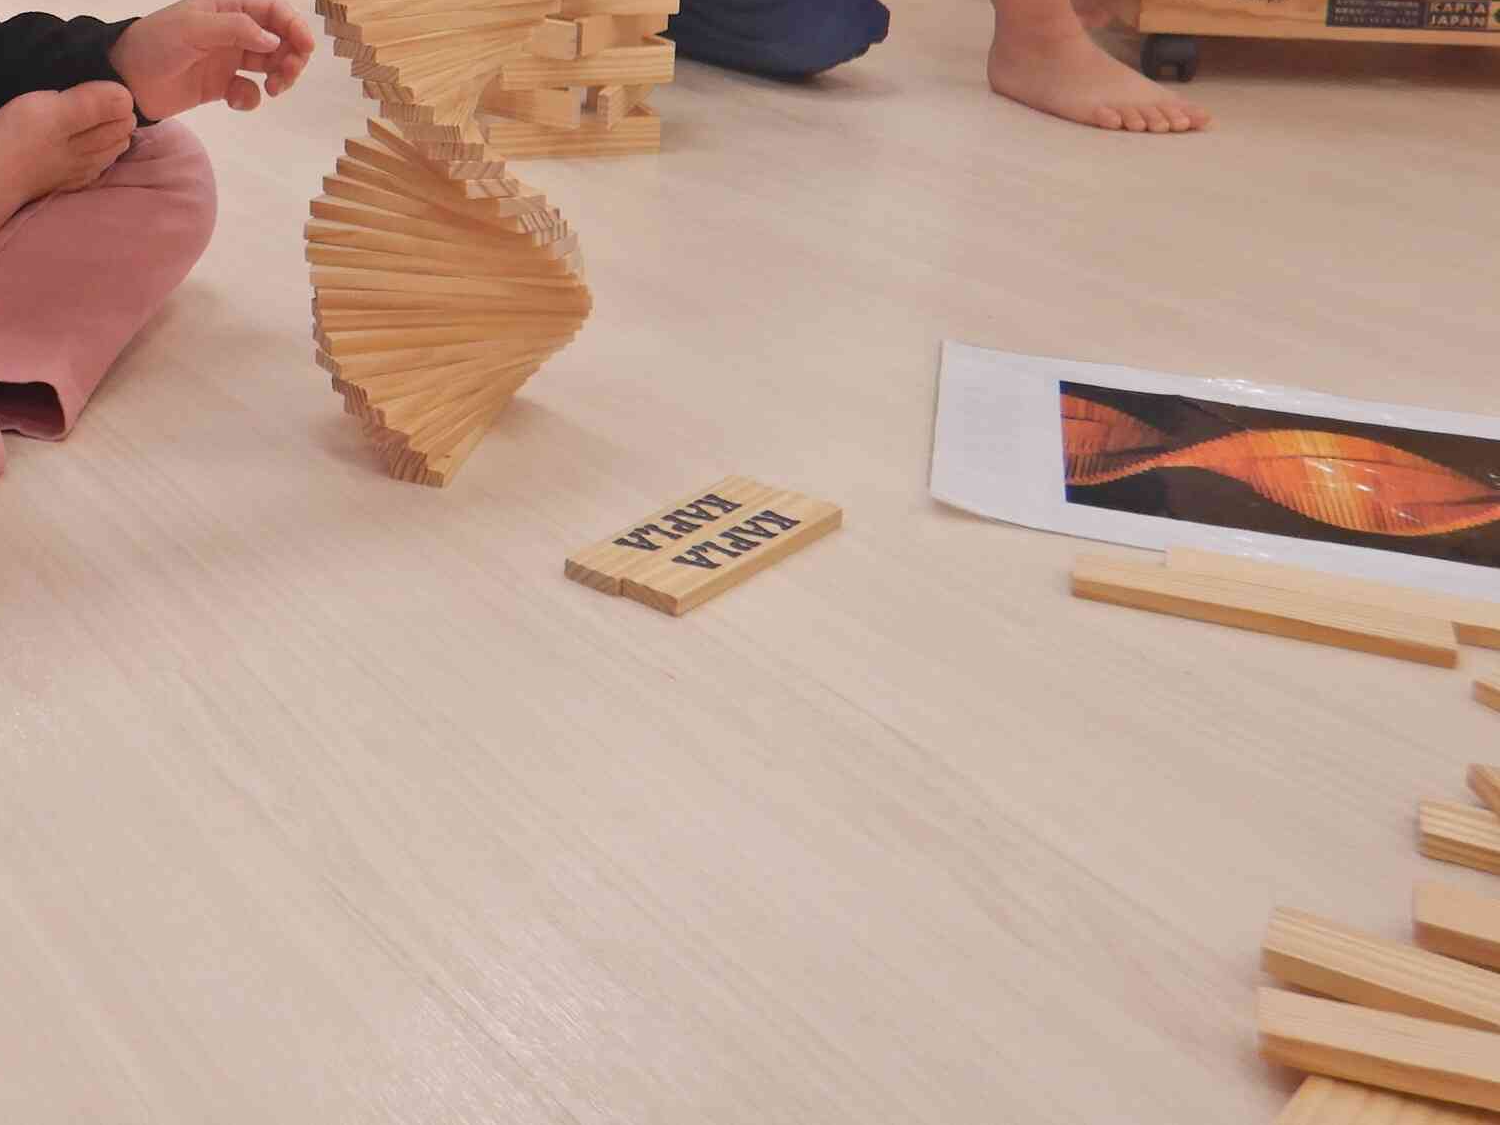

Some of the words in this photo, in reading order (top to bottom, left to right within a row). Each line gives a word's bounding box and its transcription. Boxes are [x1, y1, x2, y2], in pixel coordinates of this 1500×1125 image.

[1429, 15, 1485, 28] JAPAN
[1430, 1, 1486, 14] KAPLA
[612, 493, 742, 551] KAPLA
[672, 509, 801, 570] KAPLA
